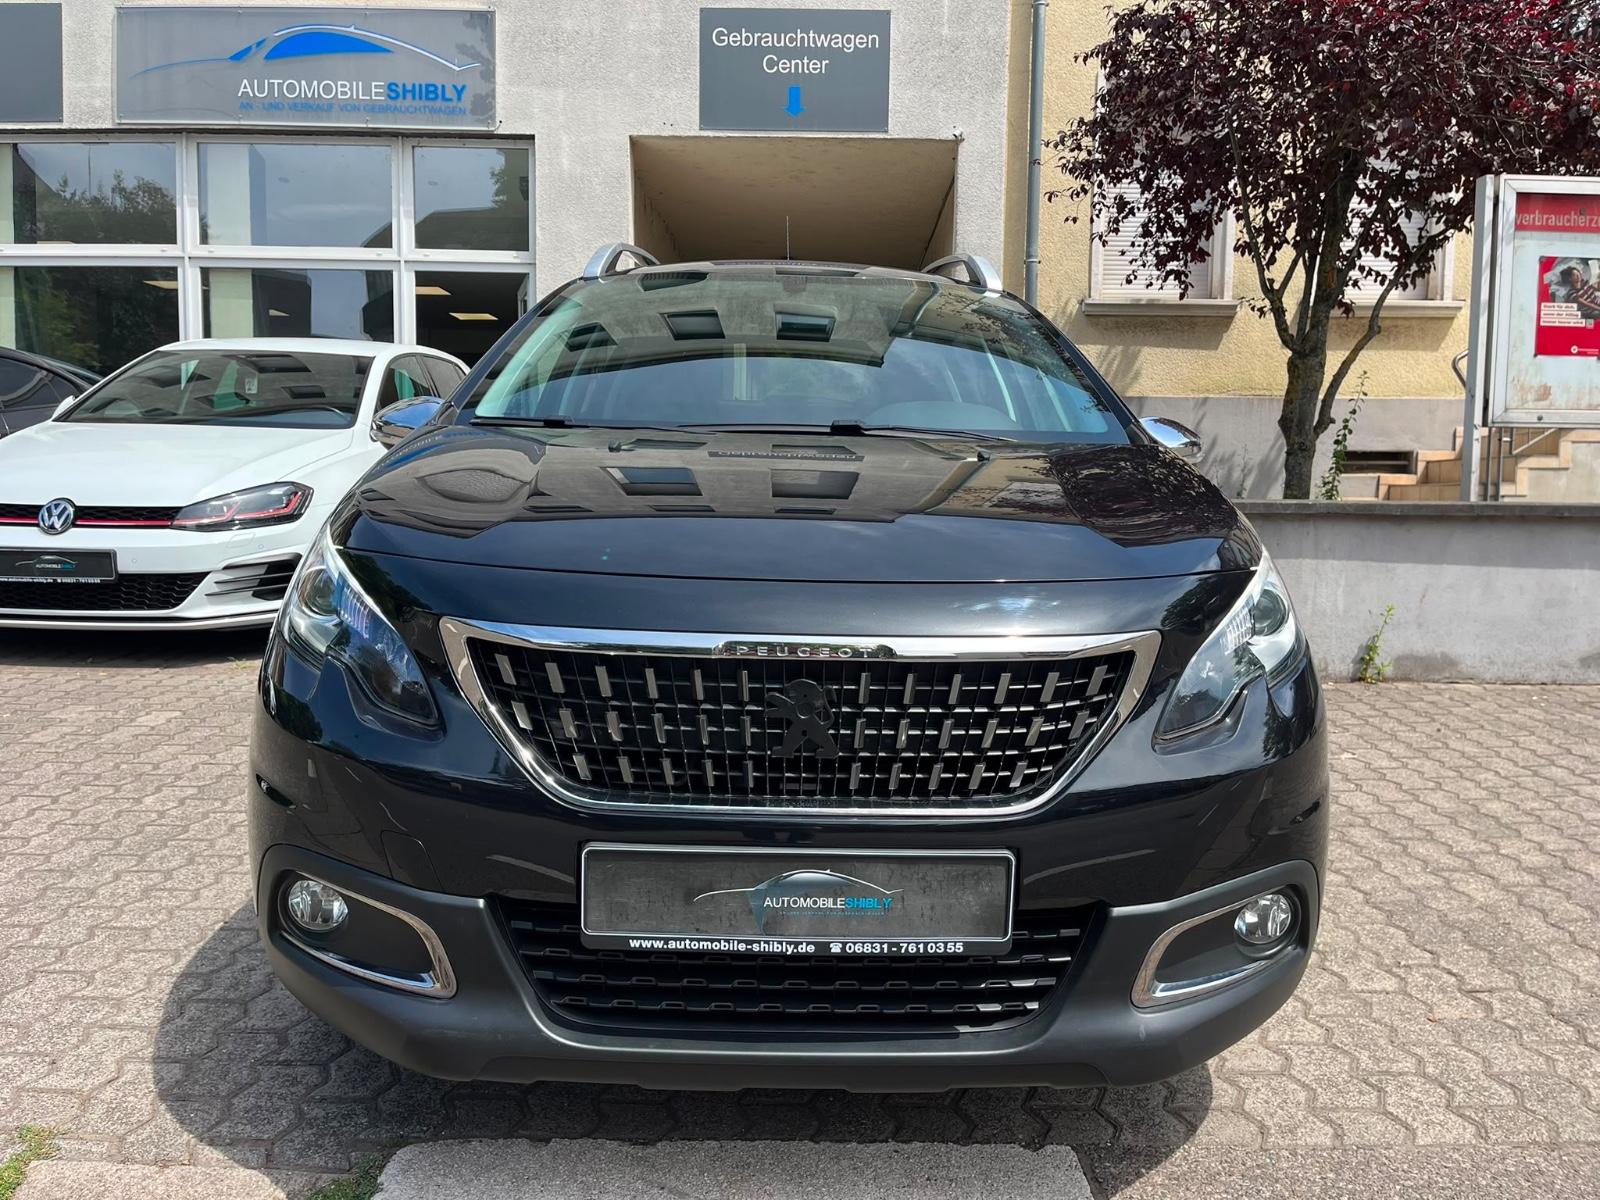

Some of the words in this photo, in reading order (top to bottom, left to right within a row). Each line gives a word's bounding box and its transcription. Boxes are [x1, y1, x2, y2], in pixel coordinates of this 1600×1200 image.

[711, 27, 879, 52] Gebrauchtwagen
[762, 54, 829, 74] Center
[262, 102, 285, 112] UND
[288, 102, 333, 113] VERKAUF
[339, 103, 360, 113] VON
[363, 103, 466, 115] GEBRAUCHTWAGEN
[1516, 209, 1600, 227] verbraucherz
[736, 645, 873, 658] PEUGEOT
[628, 938, 816, 955] www.automobile-shibly.de
